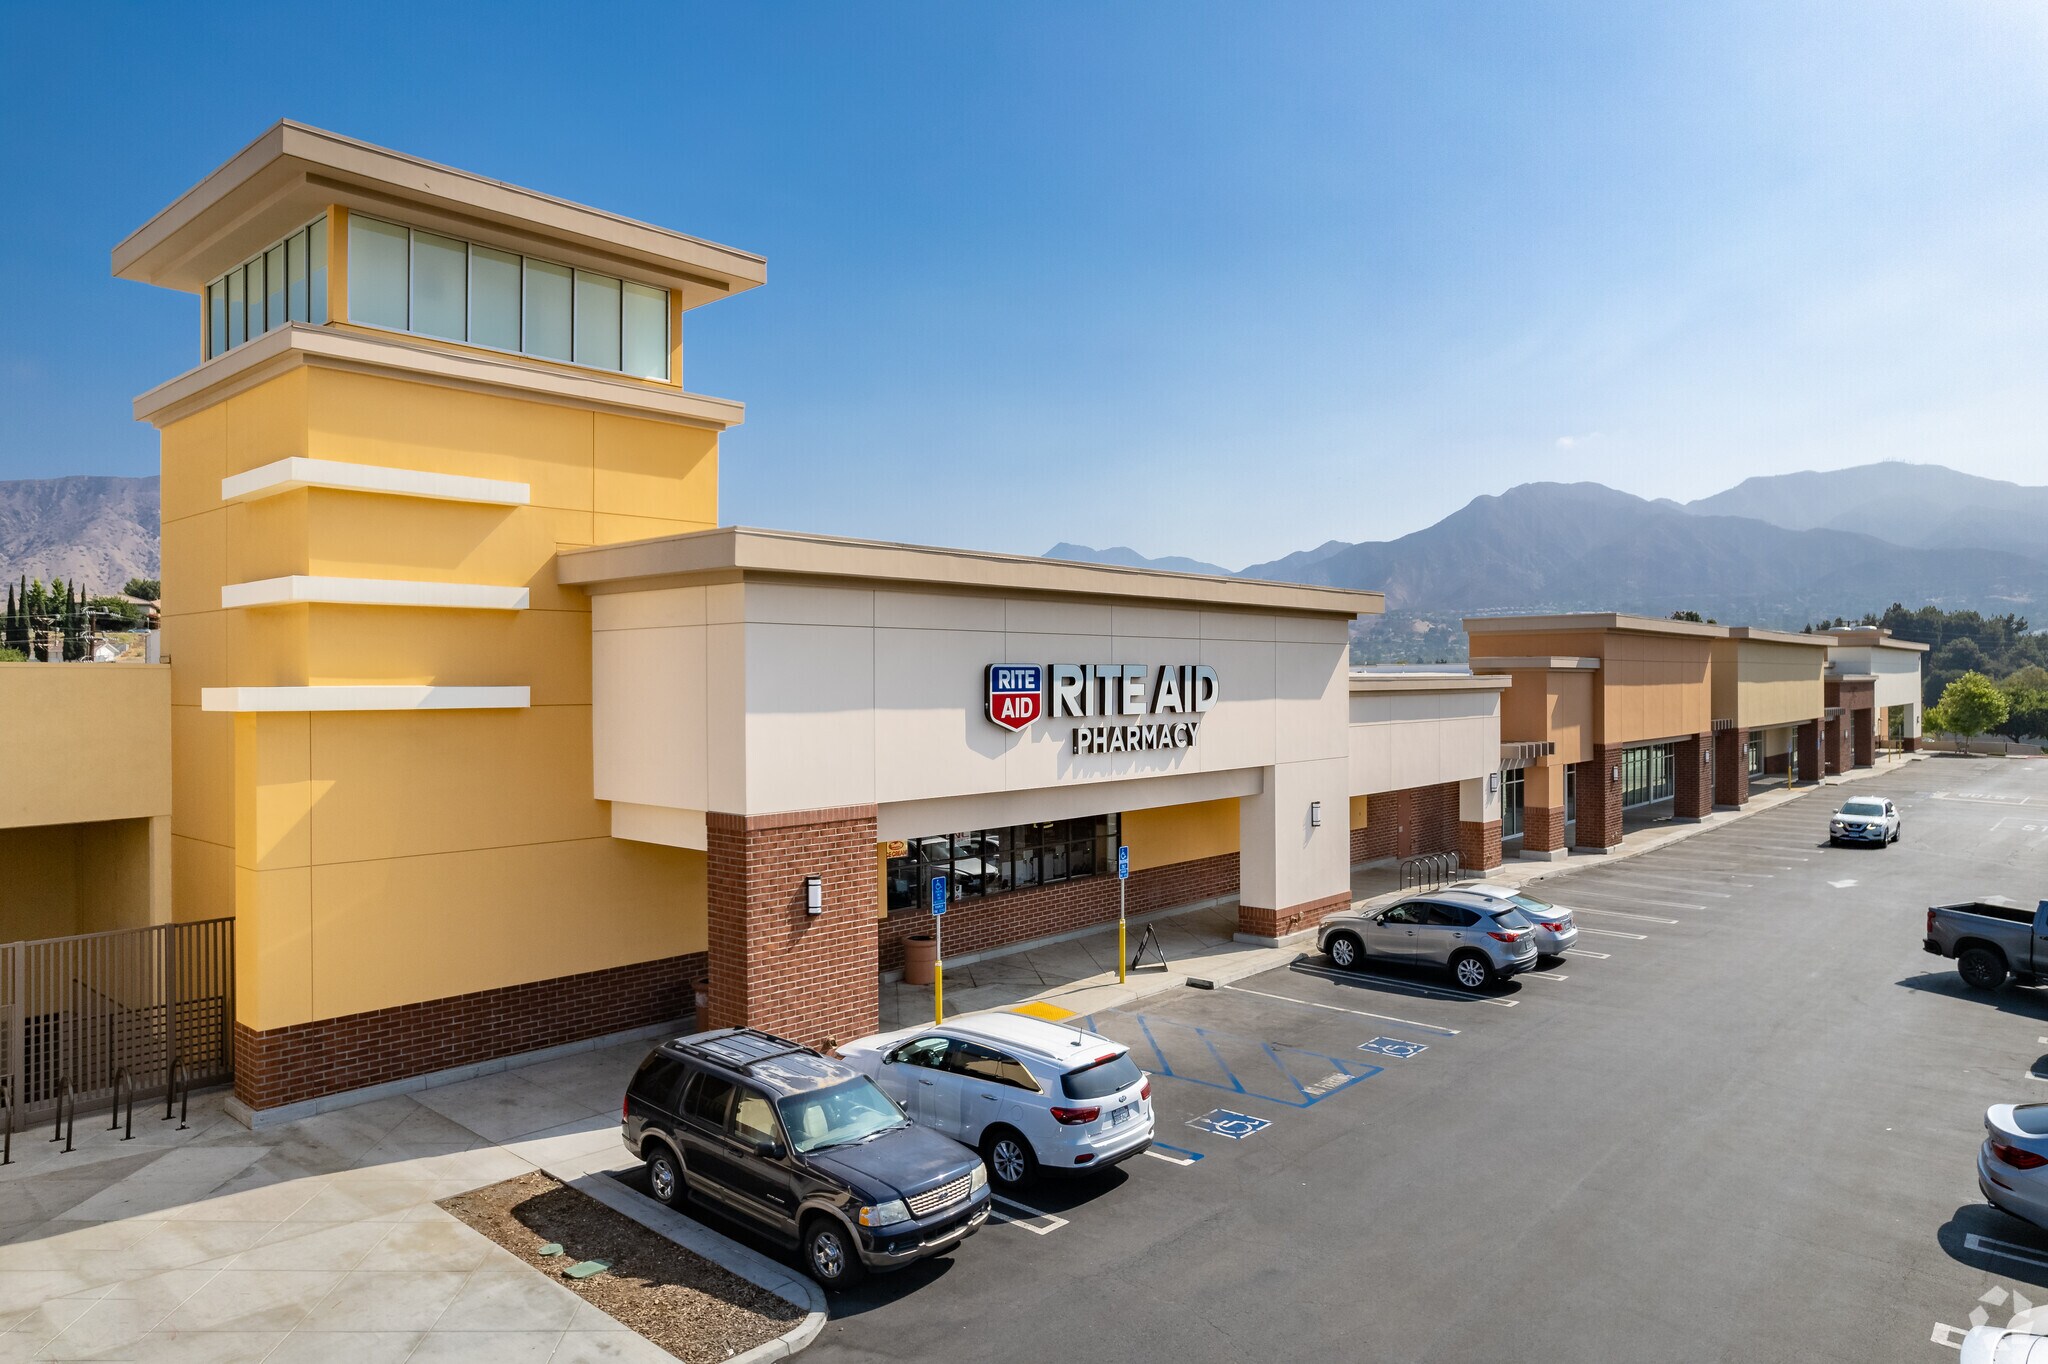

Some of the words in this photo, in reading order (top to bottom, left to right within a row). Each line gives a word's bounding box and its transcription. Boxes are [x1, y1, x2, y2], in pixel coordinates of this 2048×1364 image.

[998, 670, 1036, 690] RITE
[1051, 664, 1148, 718] RITE
[1153, 664, 1220, 714] AID
[1000, 697, 1033, 719] AID
[1075, 722, 1200, 754] PHARMACY
